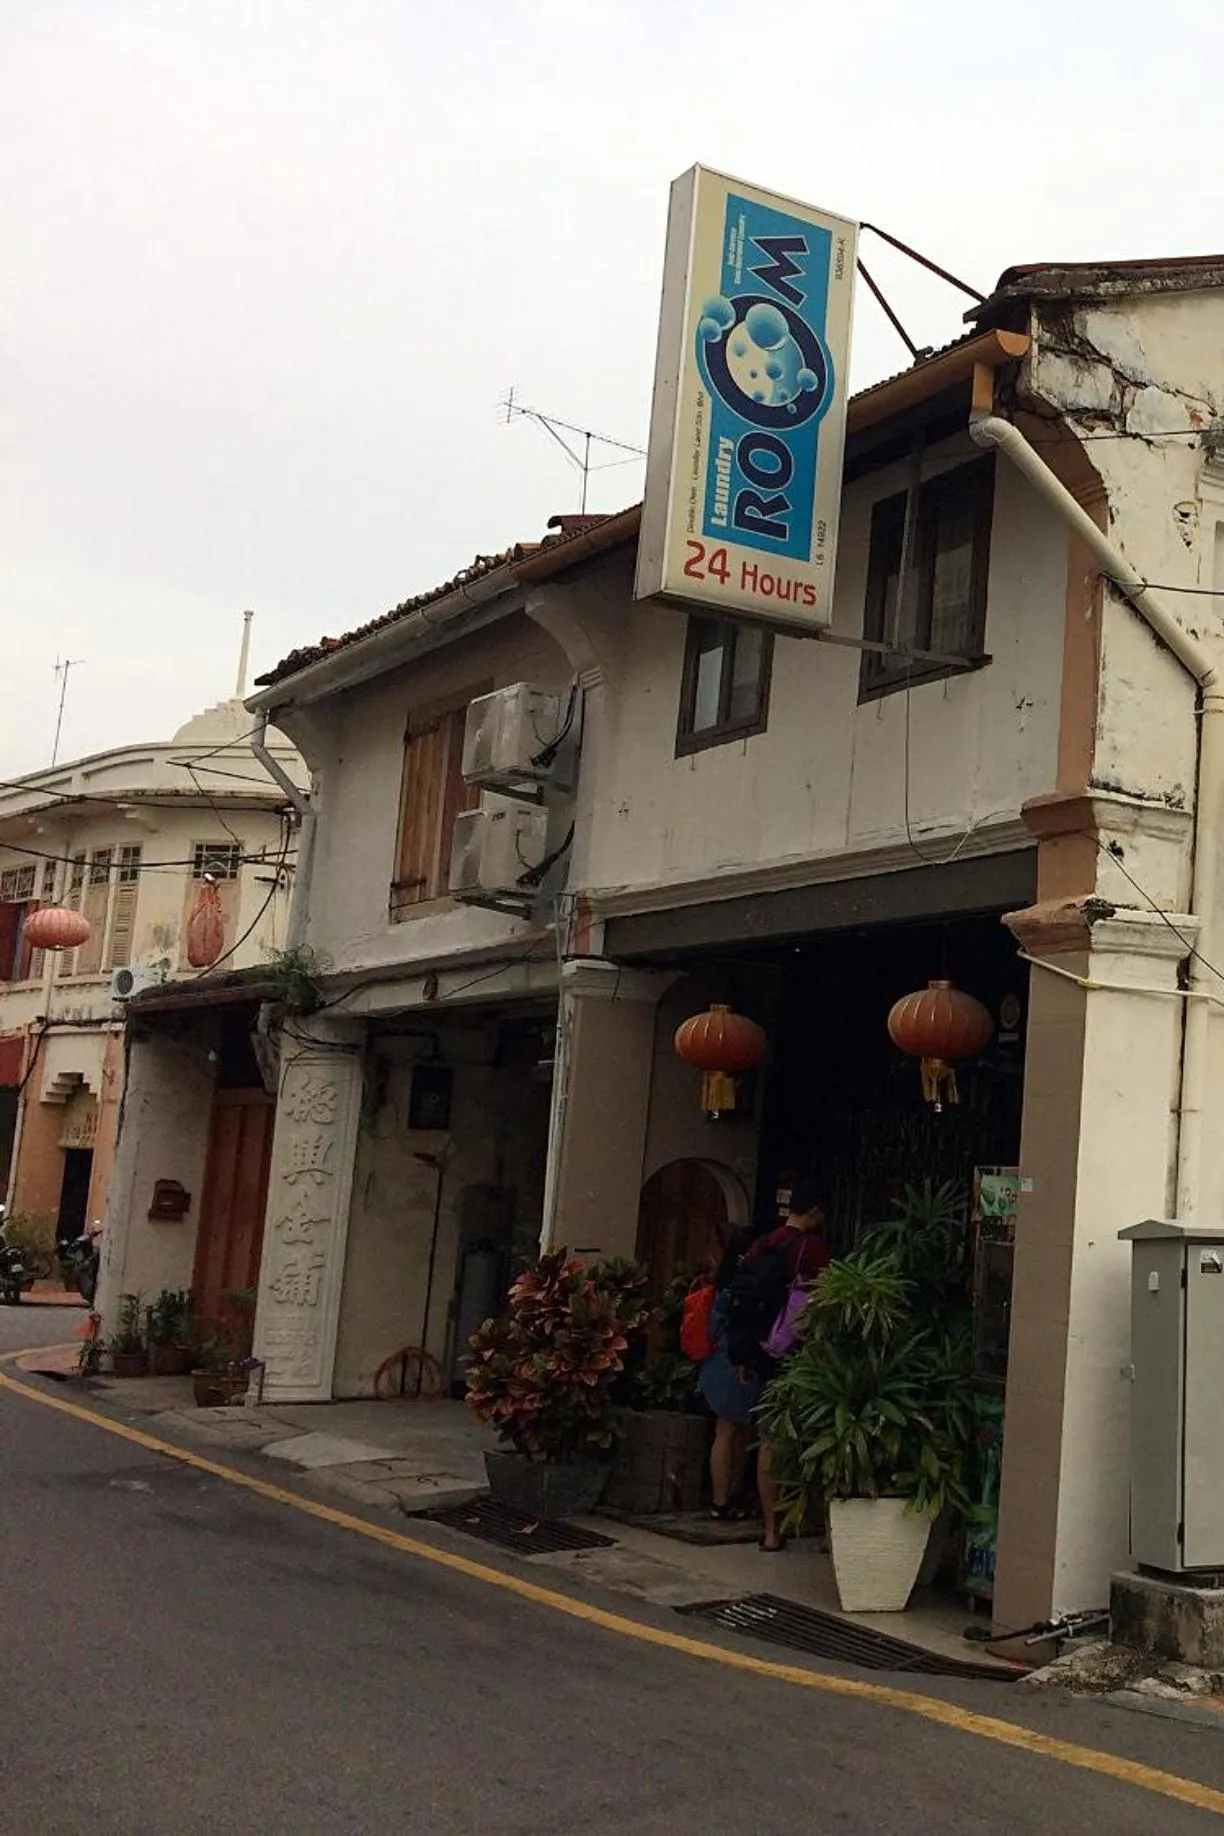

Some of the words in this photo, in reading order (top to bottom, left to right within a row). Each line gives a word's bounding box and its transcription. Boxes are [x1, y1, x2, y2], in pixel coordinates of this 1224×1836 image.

[703, 234, 828, 542] ROOM
[711, 436, 734, 527] Laundry
[684, 540, 731, 584] 24
[740, 561, 817, 606] Hours
